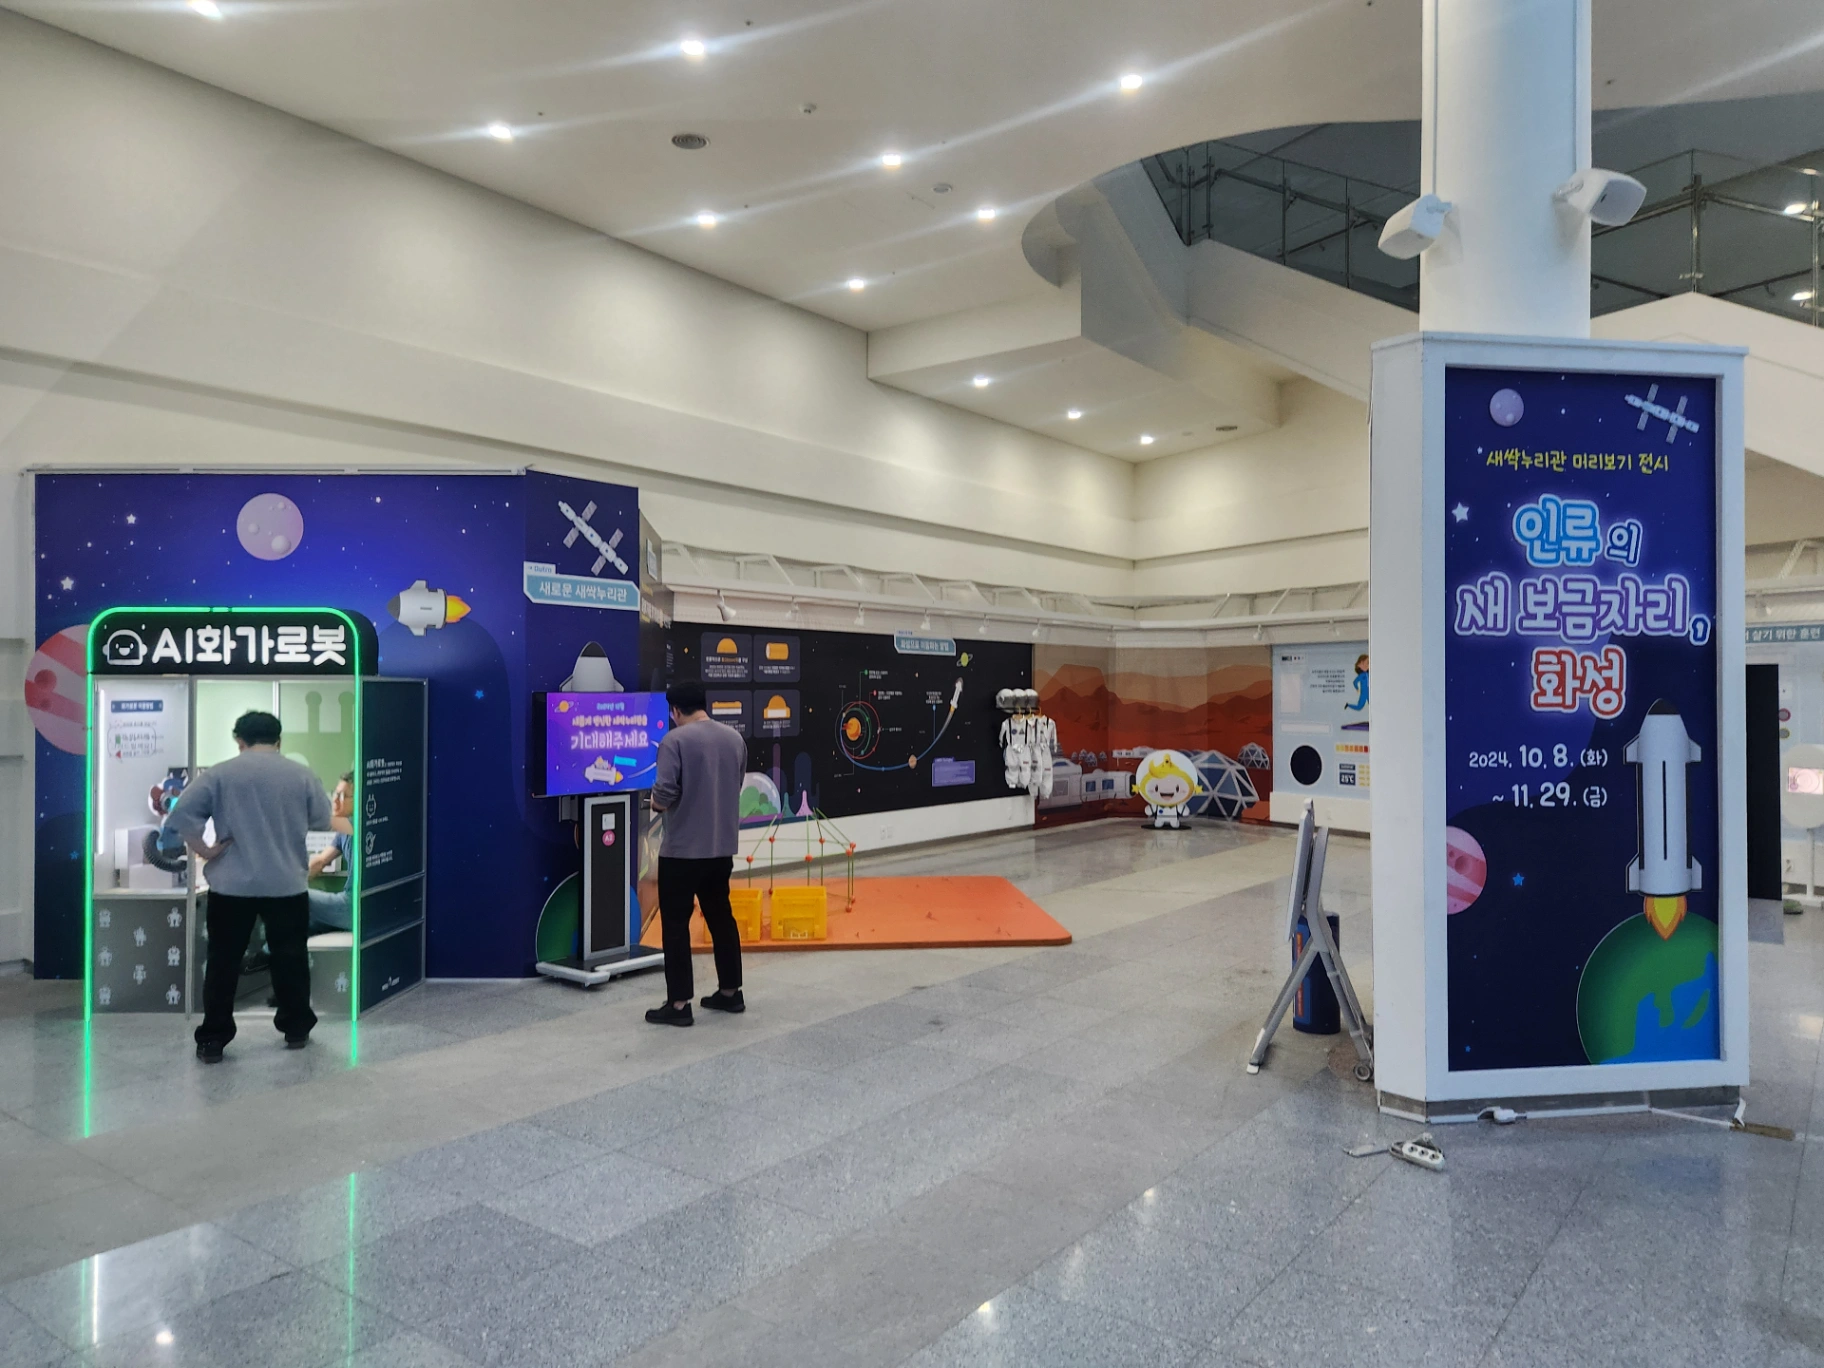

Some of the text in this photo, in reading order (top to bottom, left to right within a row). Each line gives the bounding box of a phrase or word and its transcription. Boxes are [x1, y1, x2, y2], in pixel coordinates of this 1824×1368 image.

[1486, 447, 1567, 472] 새싹누리관
[1638, 452, 1669, 474] 전시
[540, 581, 572, 598] 새로운
[575, 584, 628, 603] 새싹누리관
[1455, 572, 1512, 636] 새
[151, 624, 347, 666] AI화가로봇
[1531, 647, 1626, 719] 화성
[570, 729, 649, 750] 기대해주세요
[1469, 743, 1608, 769] 2024. 10. 8. (화)
[1540, 782, 1577, 807] 29.
[1583, 786, 1607, 808] (금)
